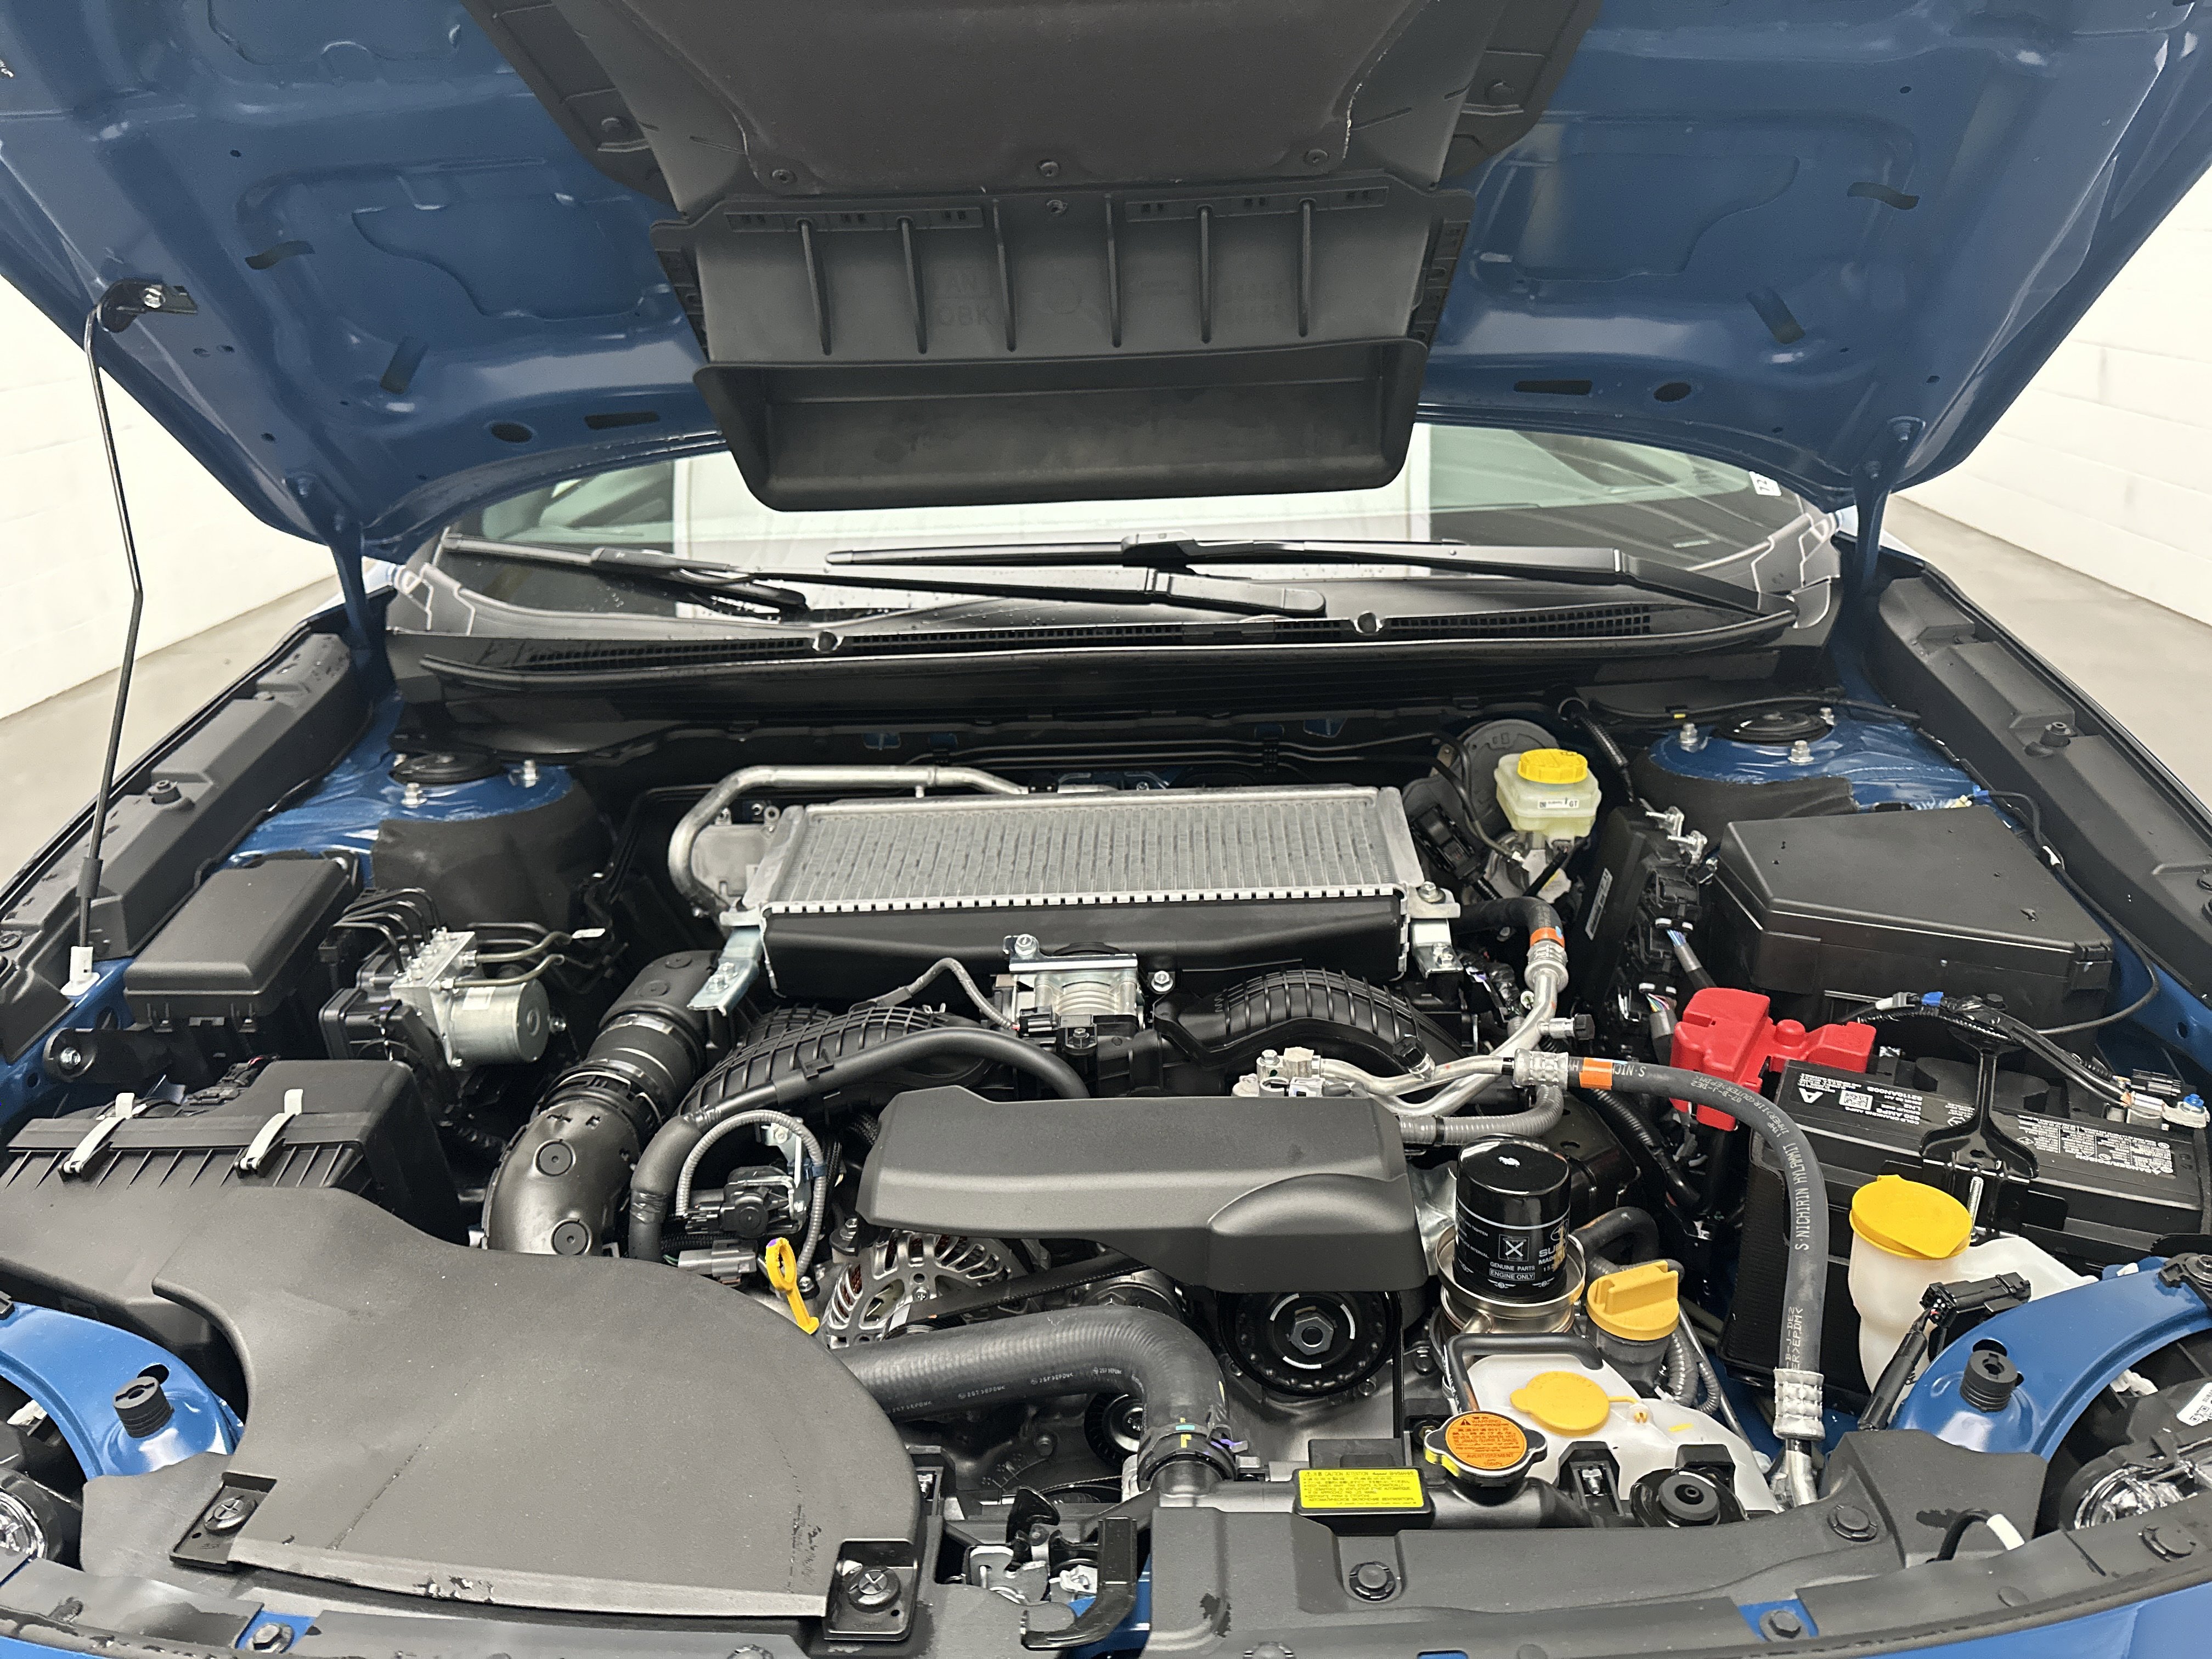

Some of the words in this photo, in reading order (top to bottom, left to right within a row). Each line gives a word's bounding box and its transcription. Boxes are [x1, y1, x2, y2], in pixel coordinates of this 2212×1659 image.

[1865, 1110, 1899, 1121] CRANKING
[1876, 1108, 1902, 1118] AMPS
[2075, 1154, 2152, 1173] DANGER/POISON
[1489, 1261, 1515, 1271] GENUINE
[1491, 1269, 1515, 1280] ENGINE
